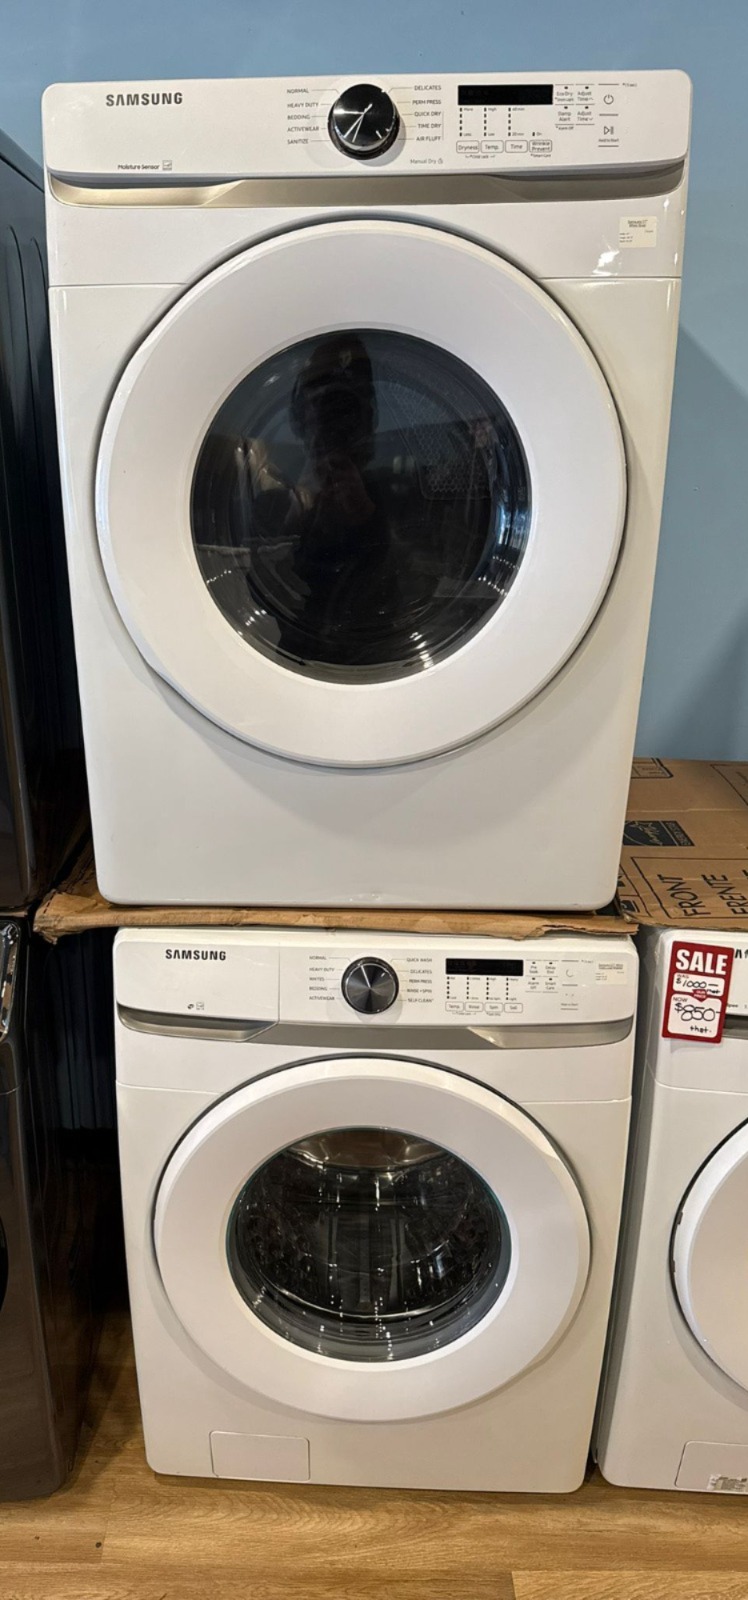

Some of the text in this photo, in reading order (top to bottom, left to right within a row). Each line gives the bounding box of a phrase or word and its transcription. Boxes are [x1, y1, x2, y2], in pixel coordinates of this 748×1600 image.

[106, 92, 183, 107] SAMSUNG
[657, 873, 712, 917] FRONT
[701, 874, 748, 915] FRENTE
[165, 949, 227, 961] SAMSUNG
[675, 948, 729, 976] SALE
